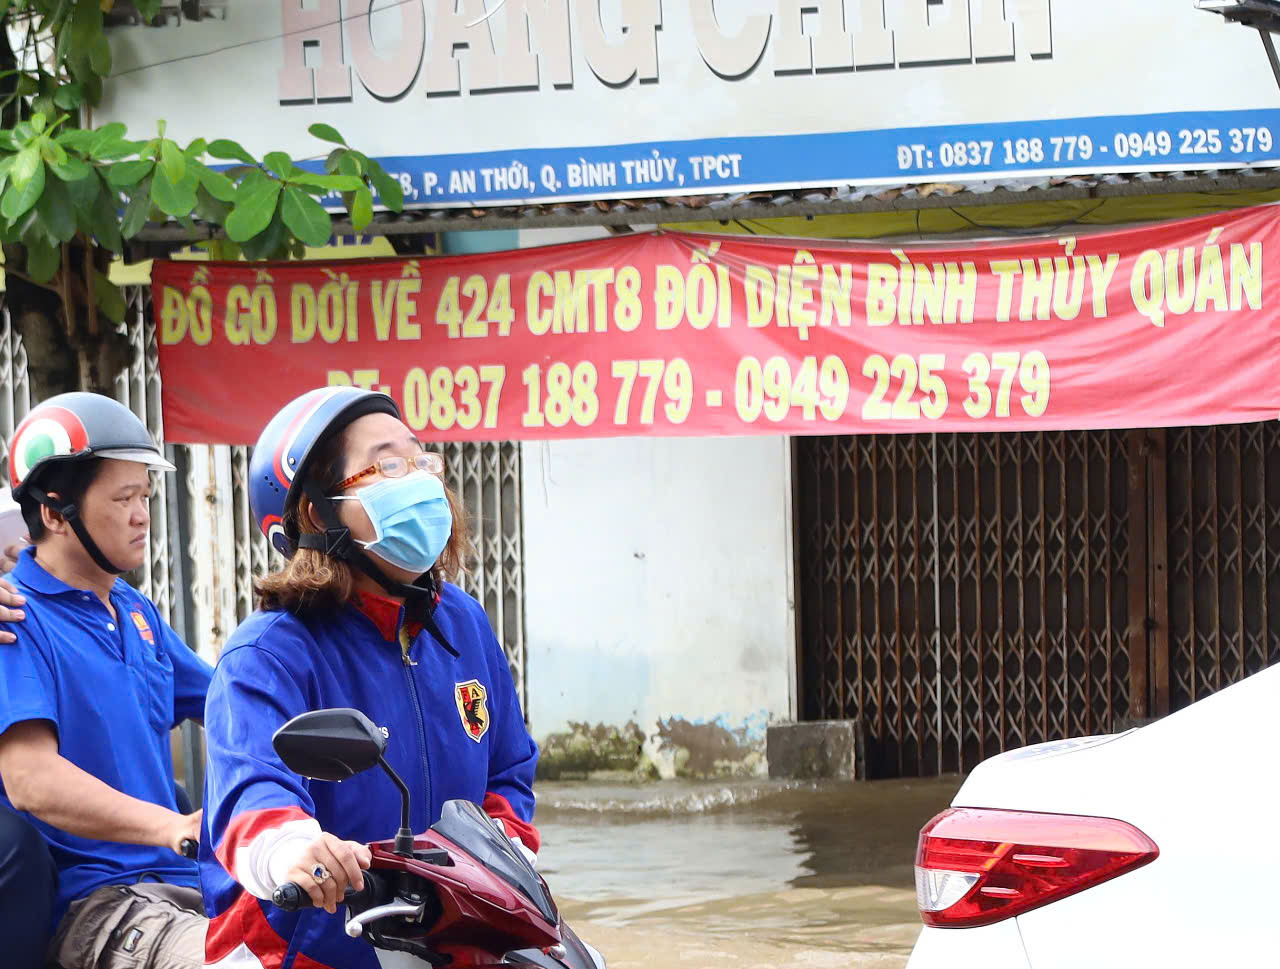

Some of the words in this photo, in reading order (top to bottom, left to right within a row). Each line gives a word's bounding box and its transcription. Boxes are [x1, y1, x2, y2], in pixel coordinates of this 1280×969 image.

[423, 172, 443, 196] P.
[449, 169, 477, 194] AN
[541, 165, 562, 192] Q.
[568, 157, 617, 188] BÌNH
[689, 154, 743, 181] TPCT
[897, 144, 934, 171] ĐT:
[939, 141, 993, 168] 0837
[1003, 137, 1045, 165] 188
[1050, 134, 1093, 161] 779
[1114, 130, 1172, 158] 0949
[1179, 128, 1222, 155] 225
[1230, 126, 1273, 153] 379
[434, 273, 516, 339] 424
[525, 265, 643, 336] CMT8
[653, 241, 732, 331] ĐỐI
[744, 249, 853, 341] DIỆN
[865, 248, 979, 328] BÌNH
[989, 236, 1120, 323] THỦY
[1129, 226, 1264, 328] QUÁN
[402, 364, 507, 432] 0837
[521, 360, 600, 428] 188
[611, 357, 694, 425] 779
[735, 353, 850, 423] 0949
[861, 353, 950, 421] 225
[962, 349, 1052, 419] 379
